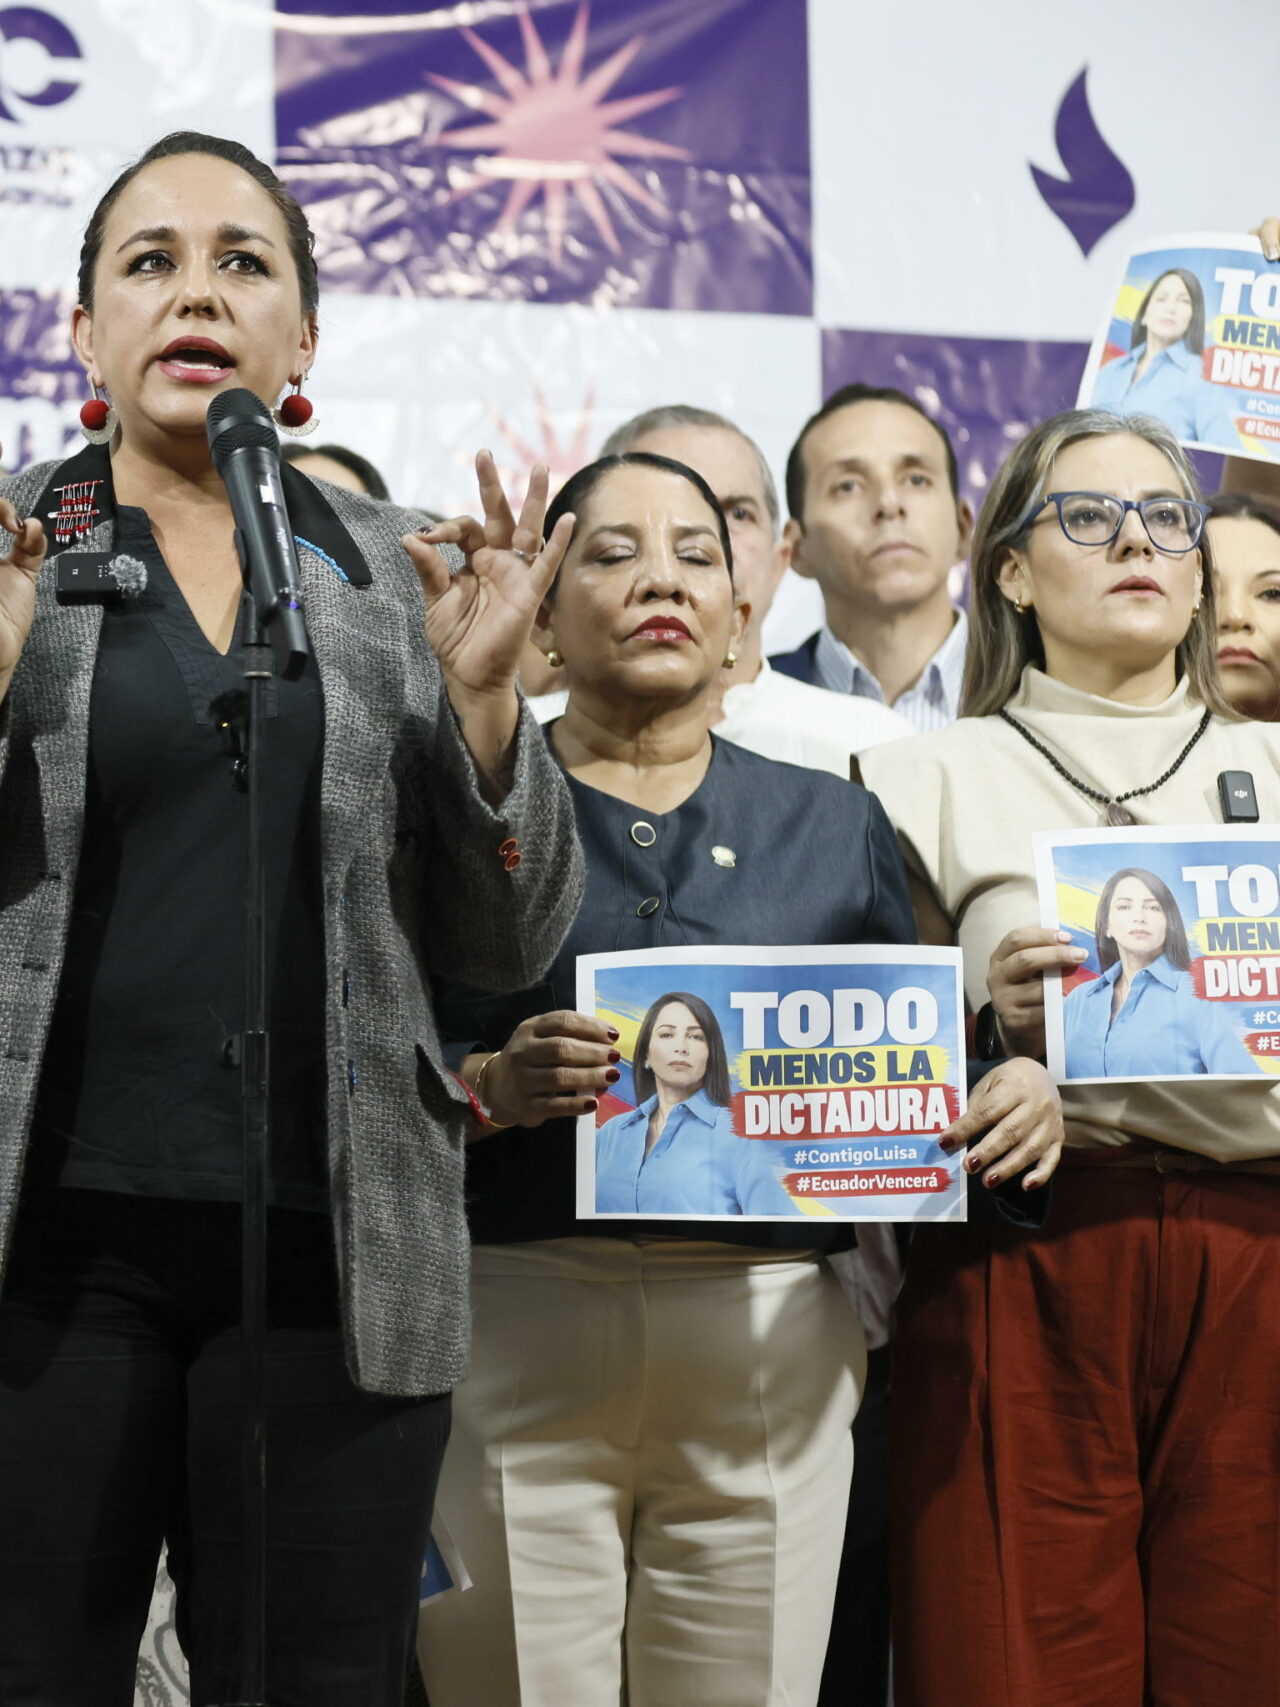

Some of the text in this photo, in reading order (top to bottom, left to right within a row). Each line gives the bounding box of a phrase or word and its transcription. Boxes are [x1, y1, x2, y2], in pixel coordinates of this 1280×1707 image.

[730, 986, 938, 1050] TODO
[750, 1050, 933, 1086] MENOS LA
[744, 1088, 951, 1136] DICTADURA
[793, 1145, 917, 1167] #ContigoLuisa
[796, 1172, 938, 1193] #EcuadorVencerá
